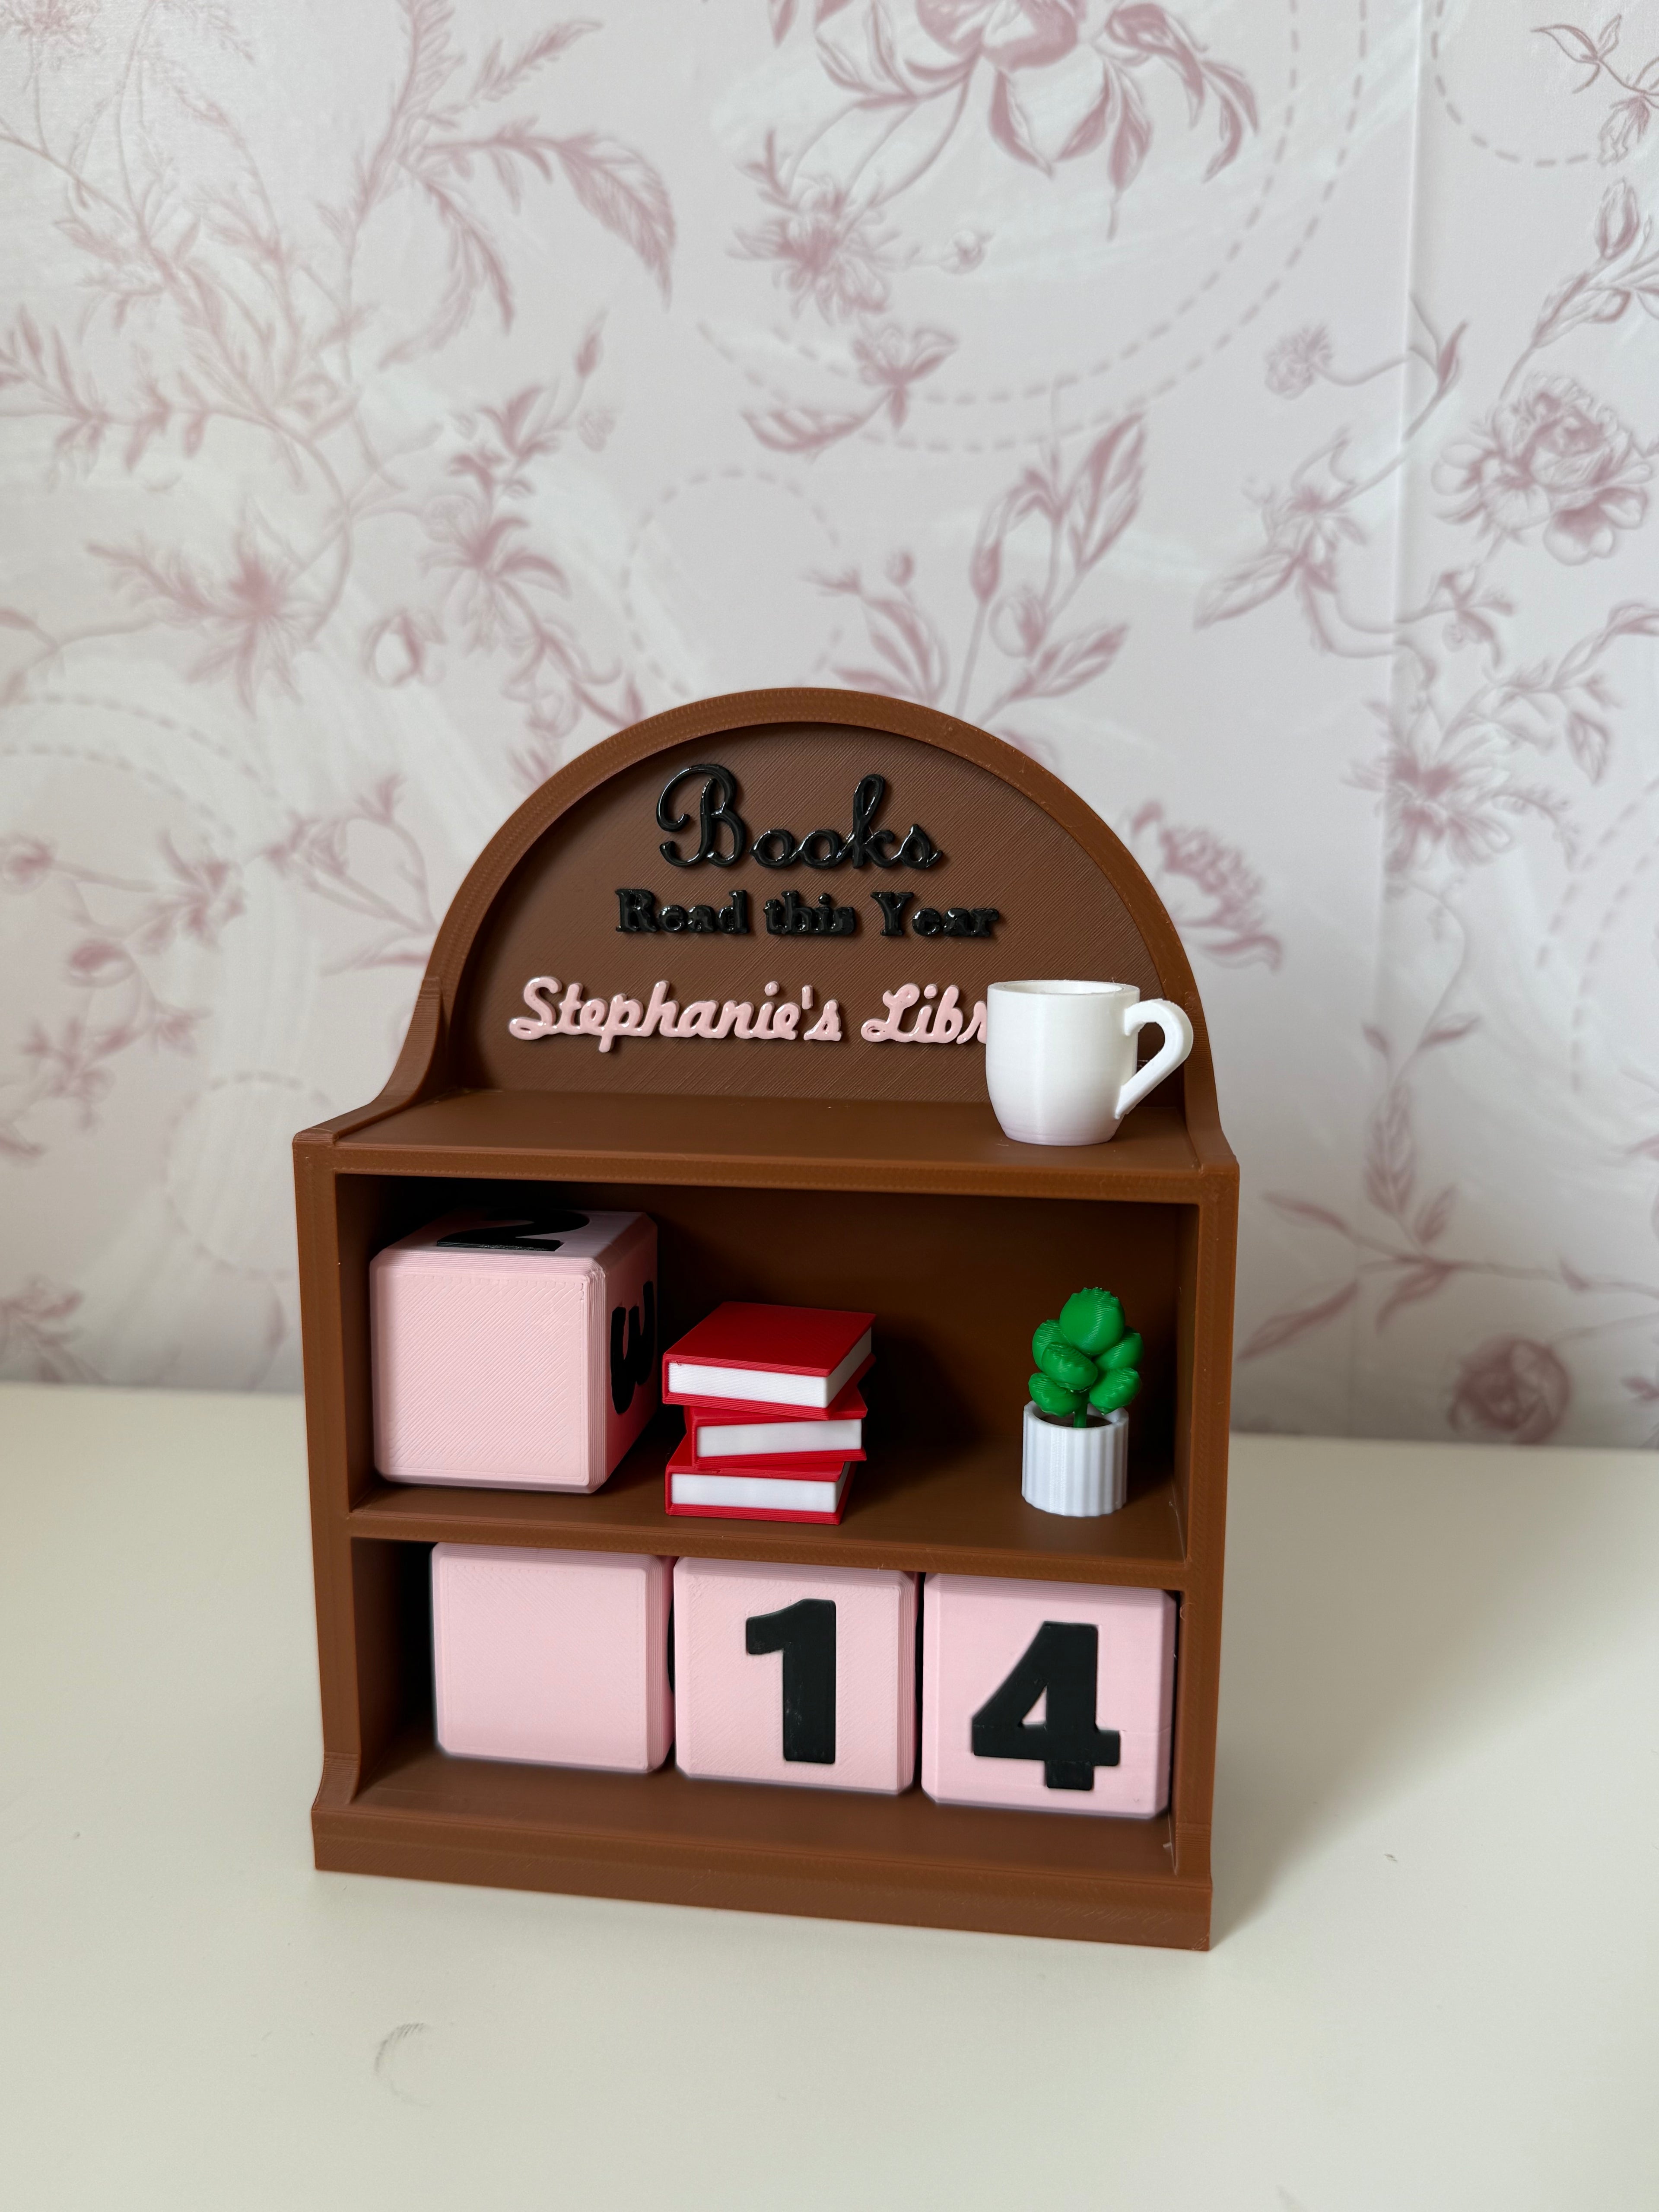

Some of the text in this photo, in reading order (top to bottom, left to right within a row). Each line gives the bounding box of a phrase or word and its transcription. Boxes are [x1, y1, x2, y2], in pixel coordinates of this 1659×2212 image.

[656, 763, 943, 869] Books
[614, 888, 1000, 938] Read this Year
[509, 976, 988, 1053] Stephanie's Libr
[436, 1208, 590, 1252] 2
[610, 1281, 655, 1414] 3
